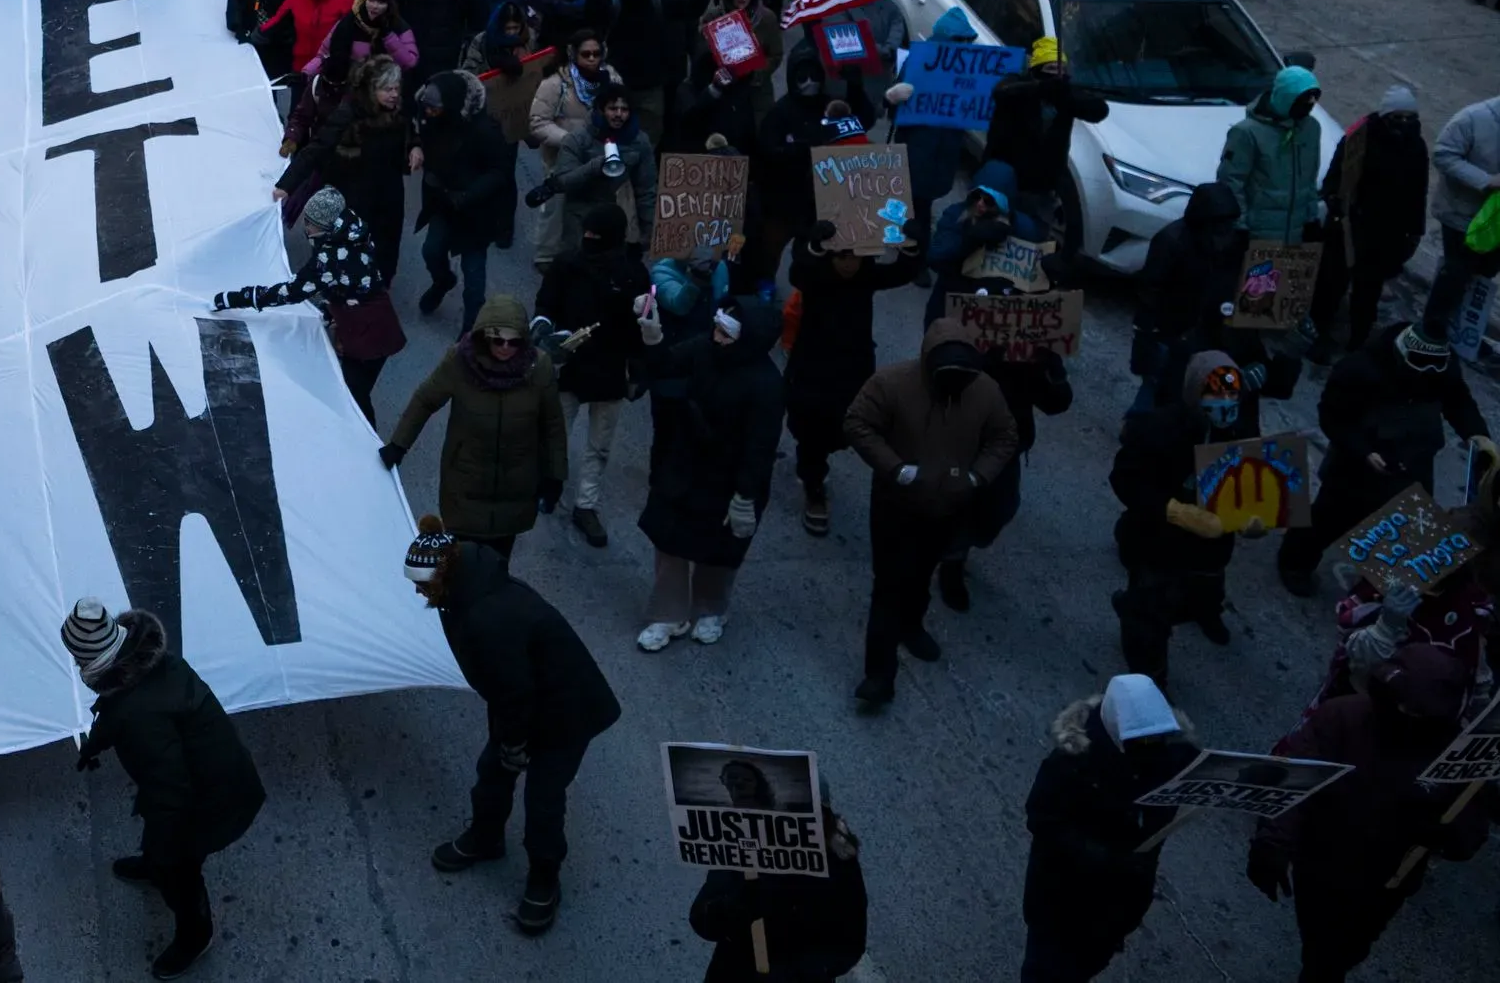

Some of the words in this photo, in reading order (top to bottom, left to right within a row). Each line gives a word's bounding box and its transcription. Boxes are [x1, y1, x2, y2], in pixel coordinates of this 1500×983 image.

[924, 44, 1013, 76] JUSTICE
[954, 77, 978, 90] FOR
[905, 92, 961, 118] RENEE
[665, 157, 747, 191] DONNY
[814, 151, 902, 185] Minnesota
[659, 192, 745, 219] DEMENTIA
[655, 221, 690, 254] HAS
[694, 218, 732, 247] G2G
[962, 307, 1063, 328] POLITICS
[1374, 542, 1410, 567] La
[1144, 792, 1215, 808] RENEE
[1220, 796, 1288, 816] GOOD
[1160, 780, 1311, 807] JUSTICE
[677, 807, 821, 850] JUSTICE
[678, 840, 755, 869] RENEE
[756, 848, 825, 874] GOOD
